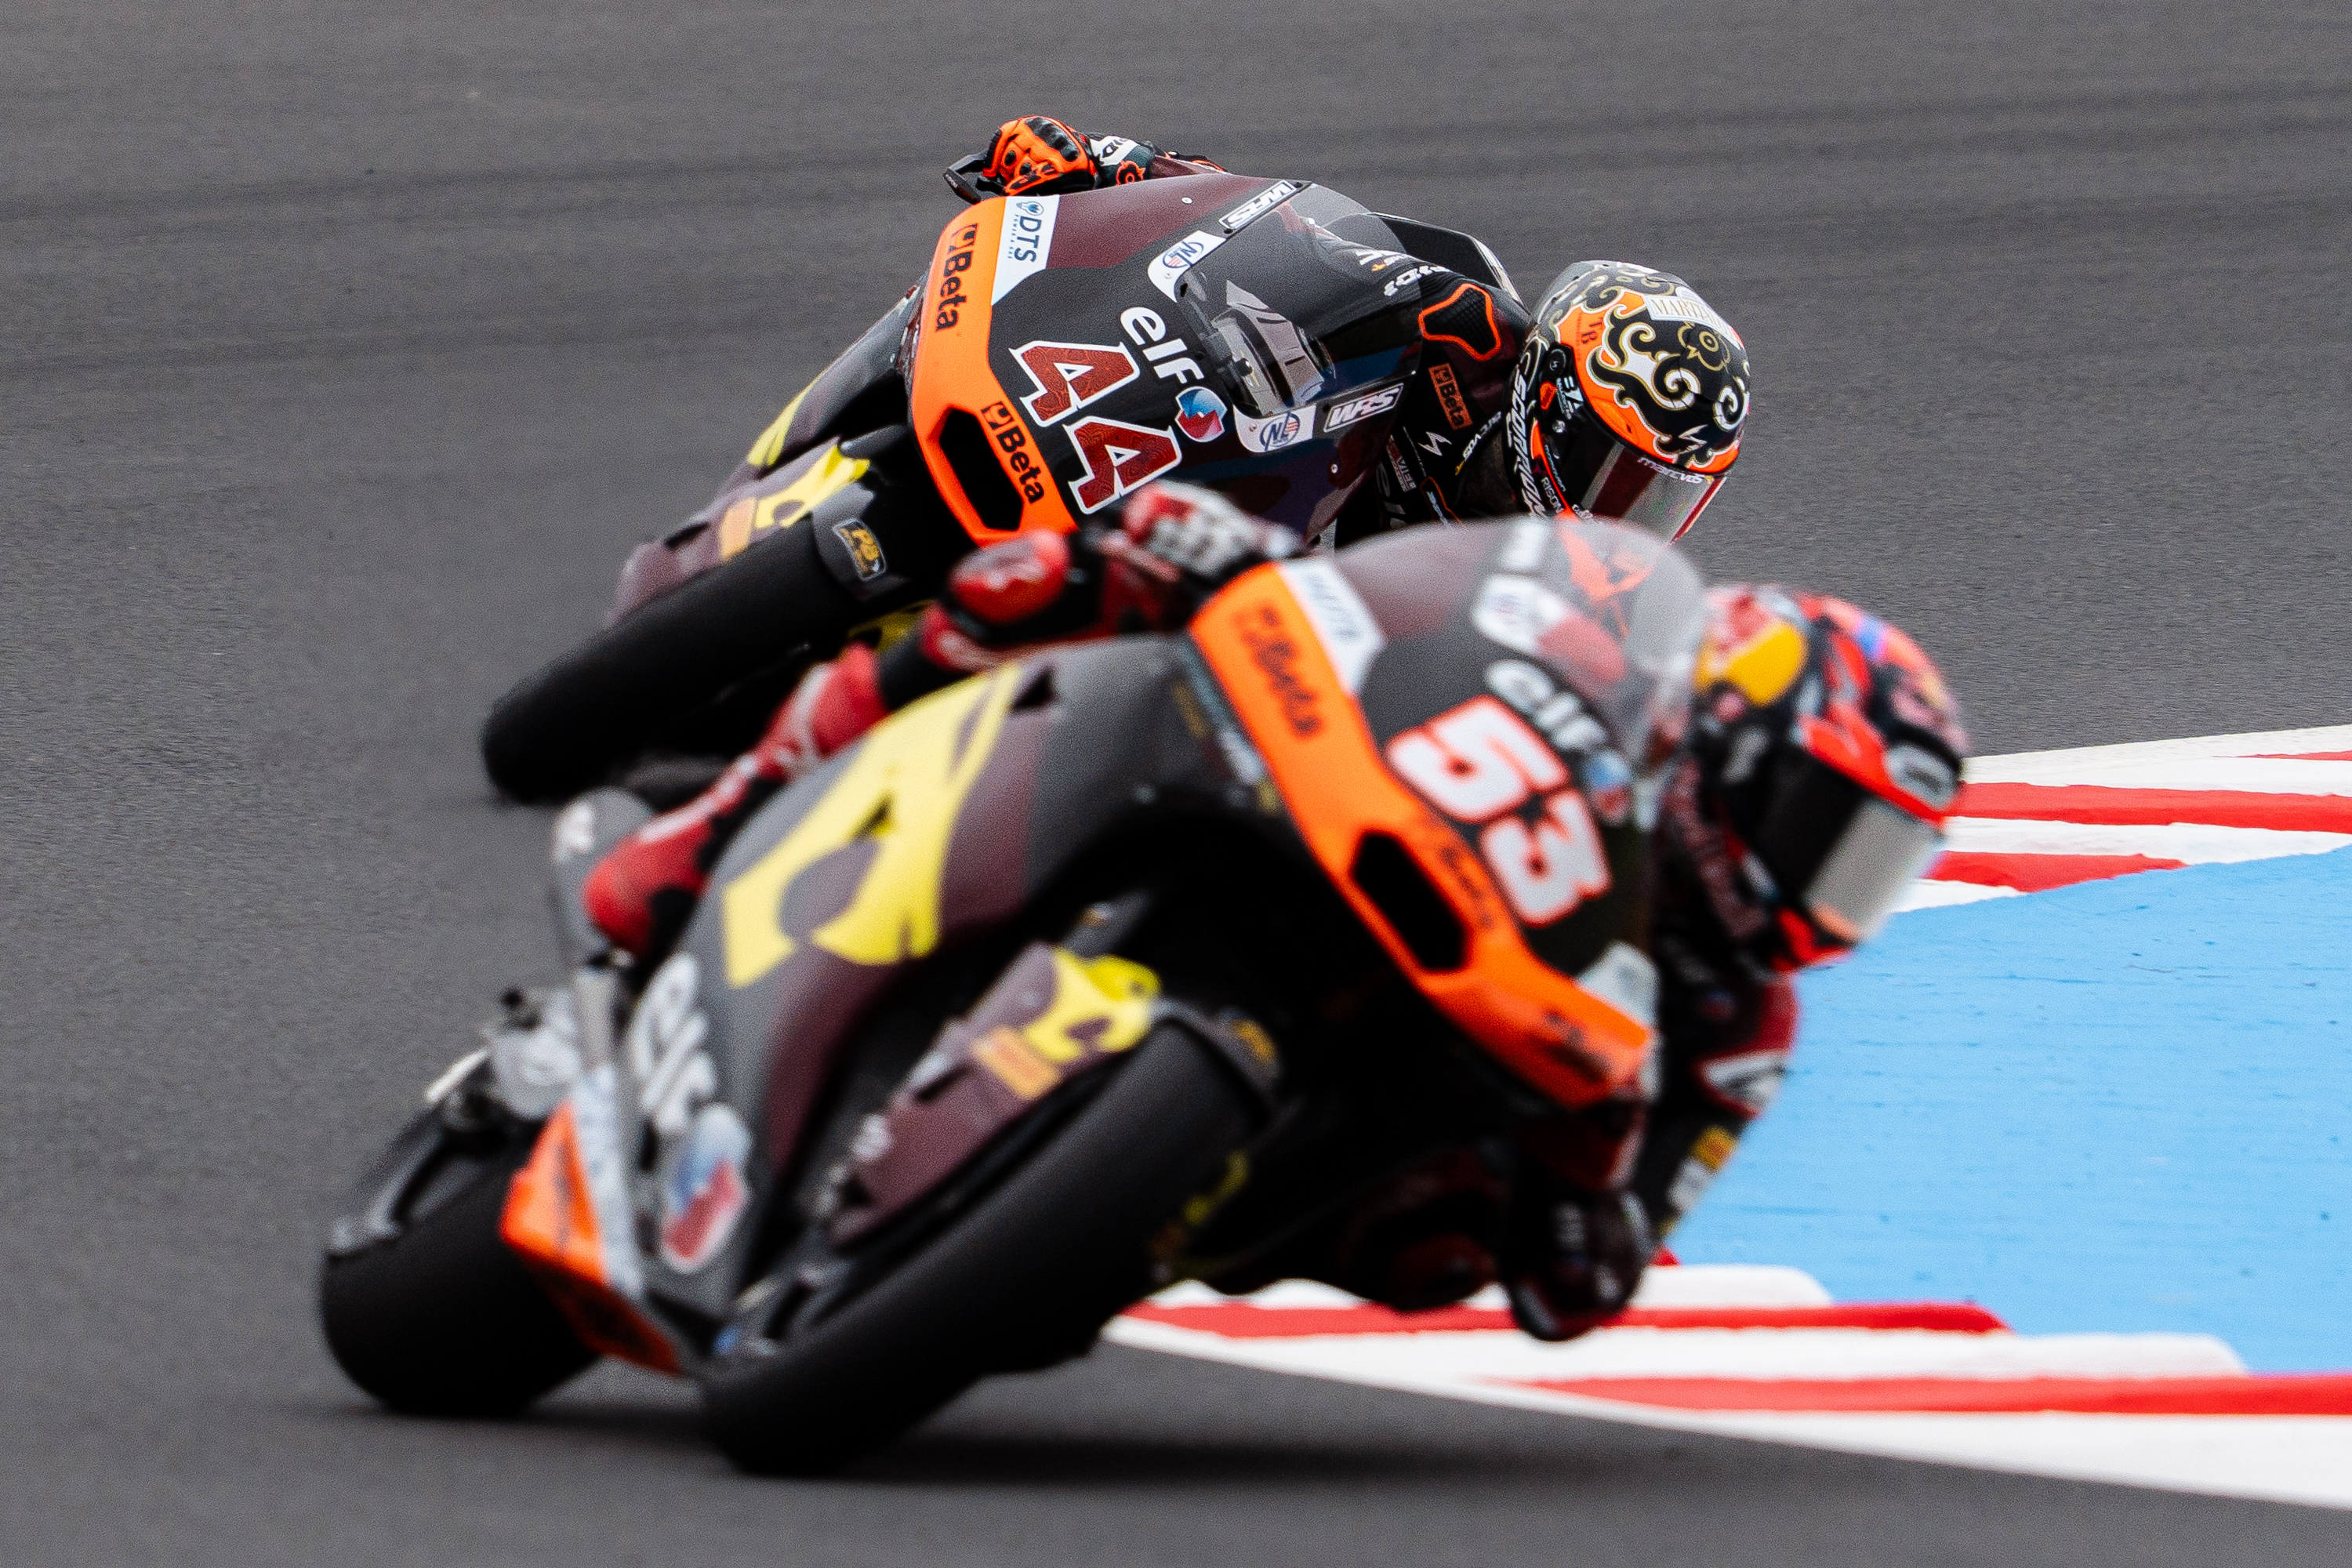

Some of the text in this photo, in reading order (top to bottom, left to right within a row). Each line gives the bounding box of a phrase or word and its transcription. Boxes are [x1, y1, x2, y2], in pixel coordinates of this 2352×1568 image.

[1014, 216, 1042, 263] DTS
[935, 251, 973, 332] Beta
[1120, 307, 1205, 385] elf
[1009, 339, 1182, 514] 44
[1328, 387, 1400, 427] WRS
[1439, 382, 1465, 428] Beta
[996, 429, 1046, 506] Beta
[1385, 693, 1612, 928] 53
